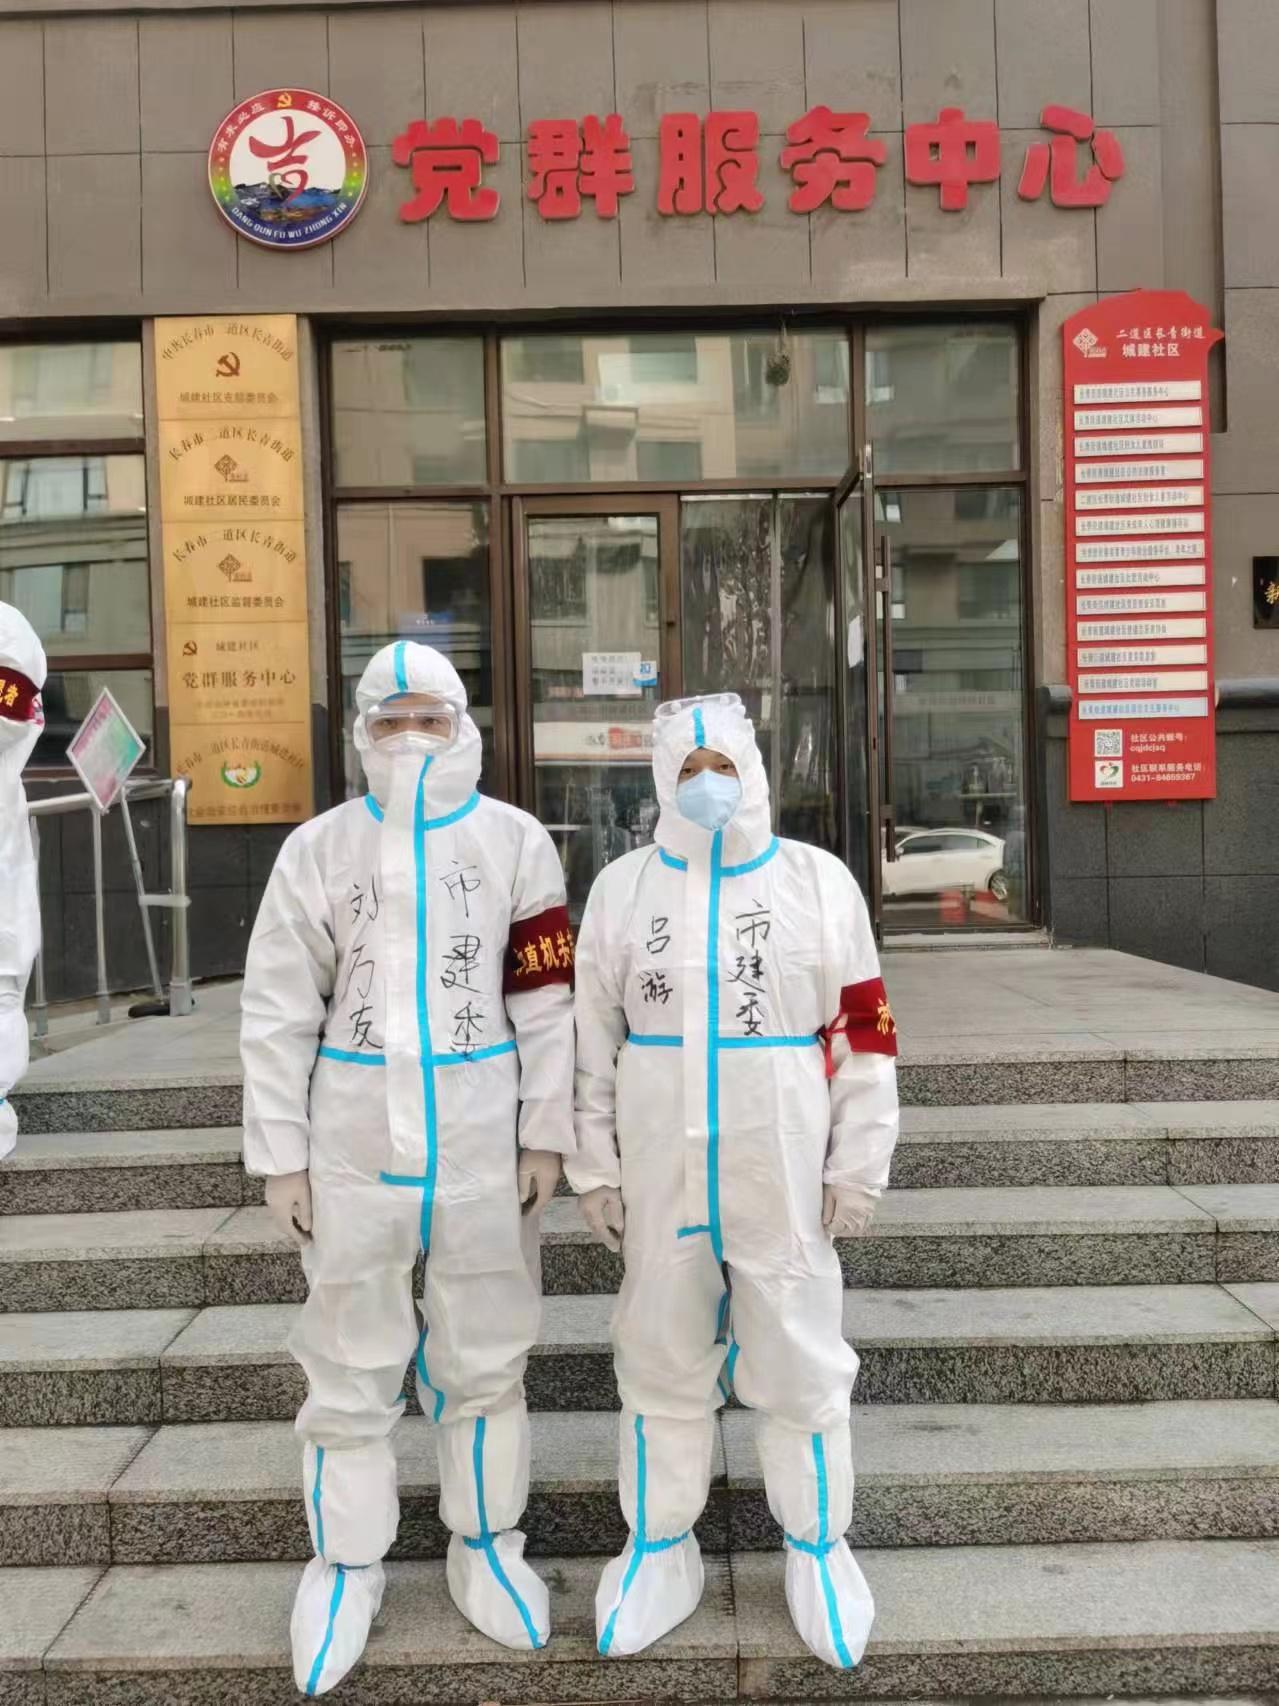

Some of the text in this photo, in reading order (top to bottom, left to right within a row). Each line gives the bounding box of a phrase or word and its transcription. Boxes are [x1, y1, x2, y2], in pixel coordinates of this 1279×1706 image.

[392, 105, 1125, 224] 党群服务中心
[1116, 326, 1206, 341] 二道区长青街道
[1122, 343, 1181, 358] 城建社区
[182, 668, 297, 689] 党群服务中心
[439, 860, 487, 1063] 市建委
[640, 915, 674, 1006] 吕游
[727, 899, 772, 1037] 市建委
